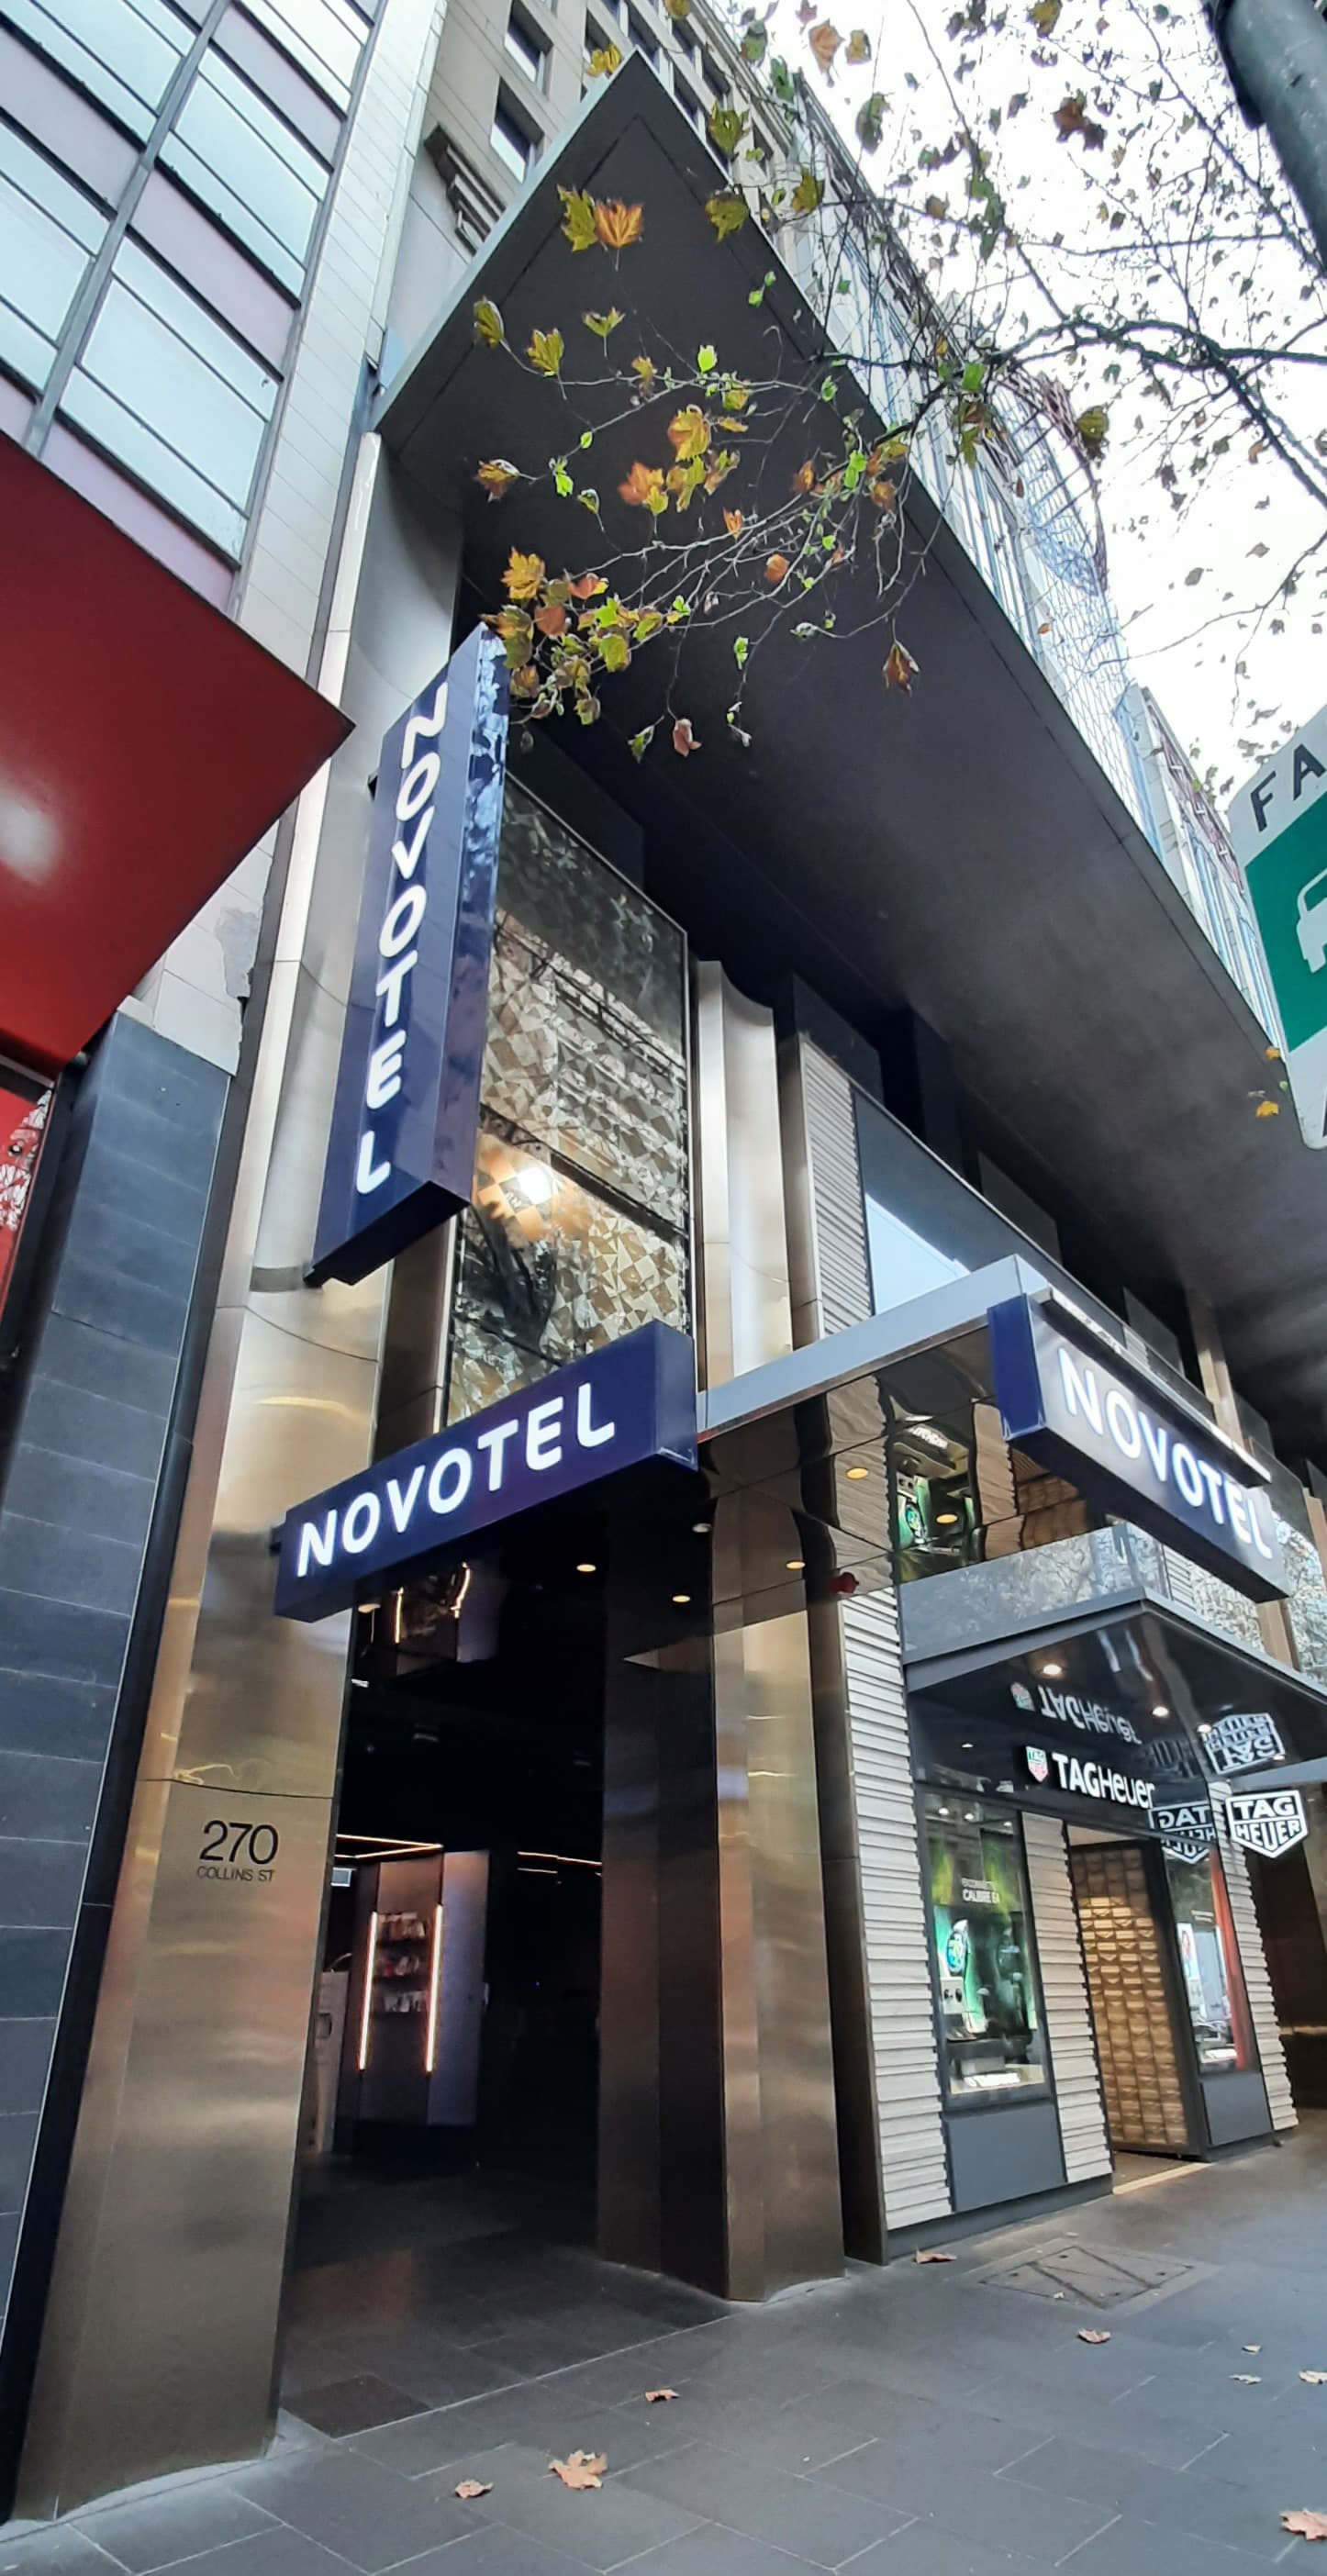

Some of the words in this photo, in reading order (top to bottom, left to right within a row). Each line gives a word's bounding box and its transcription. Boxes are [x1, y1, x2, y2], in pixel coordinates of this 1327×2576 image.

[356, 681, 448, 1195] NOVOTEL
[1058, 1347, 1274, 1559] NOVOTEL
[296, 1382, 616, 1577] NOVOTEL
[1232, 1796, 1294, 1820] TAG
[199, 1820, 279, 1865] 270
[1234, 1820, 1301, 1851] HEUER
[196, 1866, 253, 1881] COLLINS
[258, 1868, 274, 1882] ST
